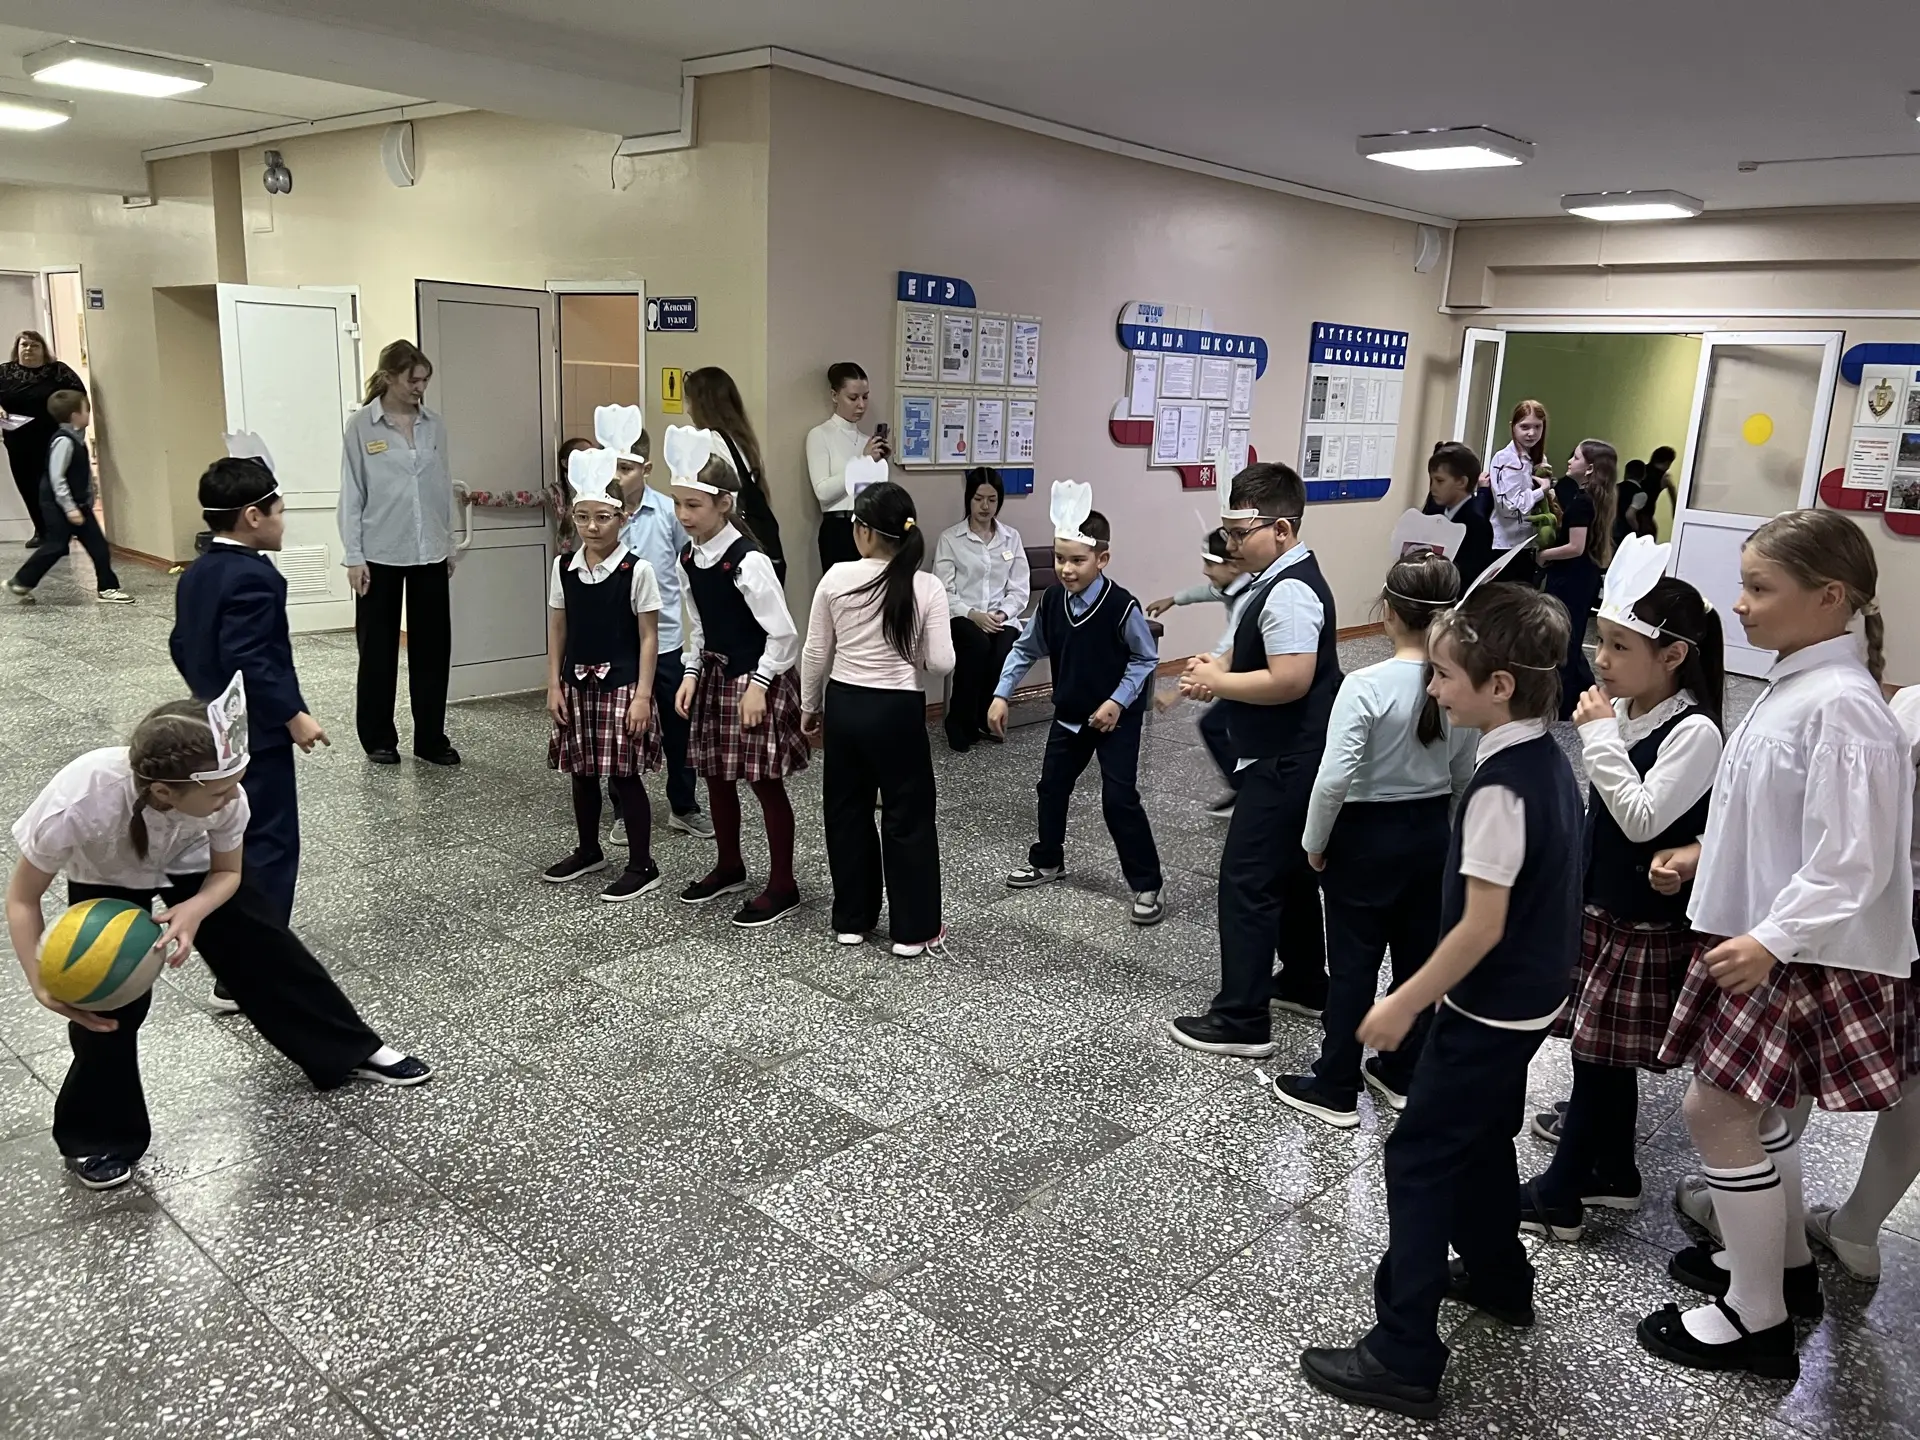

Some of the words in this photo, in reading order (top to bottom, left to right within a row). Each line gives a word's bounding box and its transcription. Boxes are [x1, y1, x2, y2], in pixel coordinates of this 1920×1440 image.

[907, 278, 955, 299] ЕГЭ
[663, 302, 692, 311] Женский
[667, 316, 688, 326] туалет
[1137, 331, 1184, 348] НАША
[1200, 336, 1256, 354] ШКОЛА
[1318, 326, 1407, 348] АТТЕСТАЦИЯ
[1324, 347, 1404, 366] ШКОЛЬНИКА
